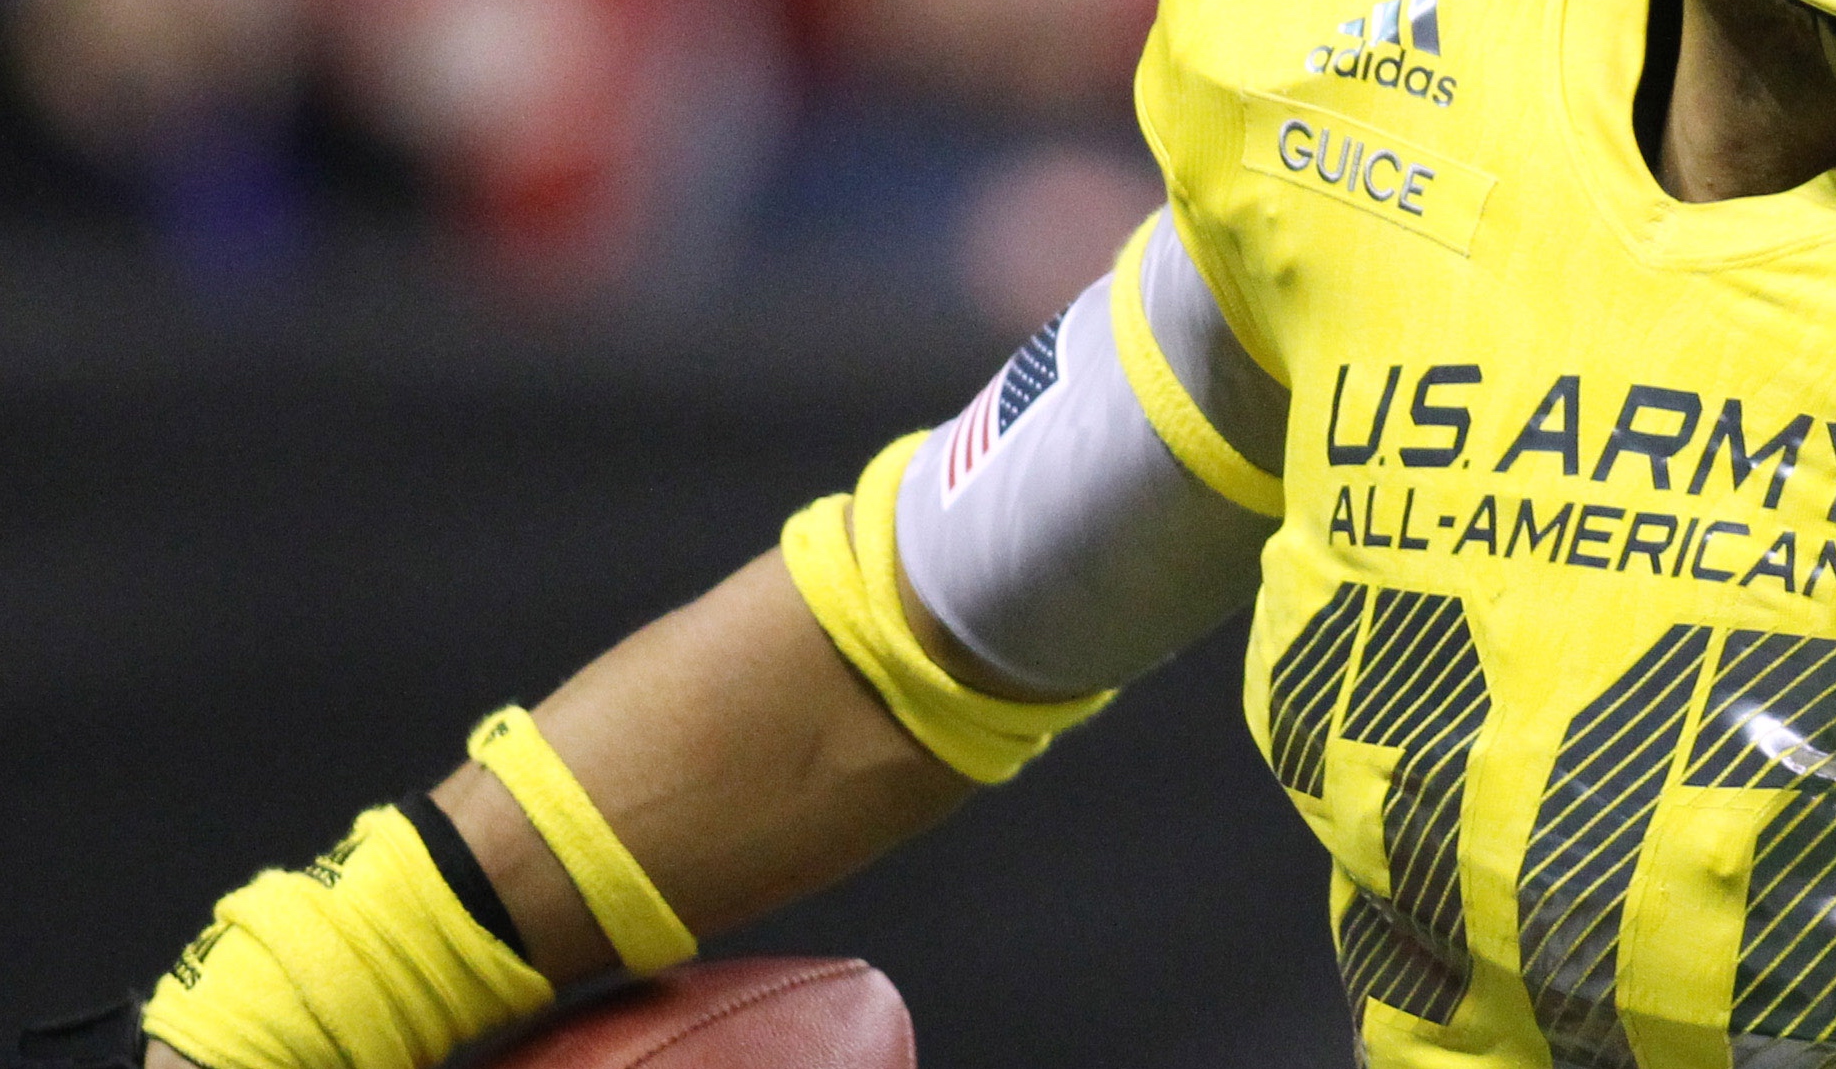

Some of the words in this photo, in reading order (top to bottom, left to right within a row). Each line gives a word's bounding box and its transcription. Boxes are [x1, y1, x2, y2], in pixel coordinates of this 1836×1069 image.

[1304, 39, 1459, 108] adidas
[1278, 118, 1436, 217] GUICE
[1326, 363, 1483, 470] U.S.
